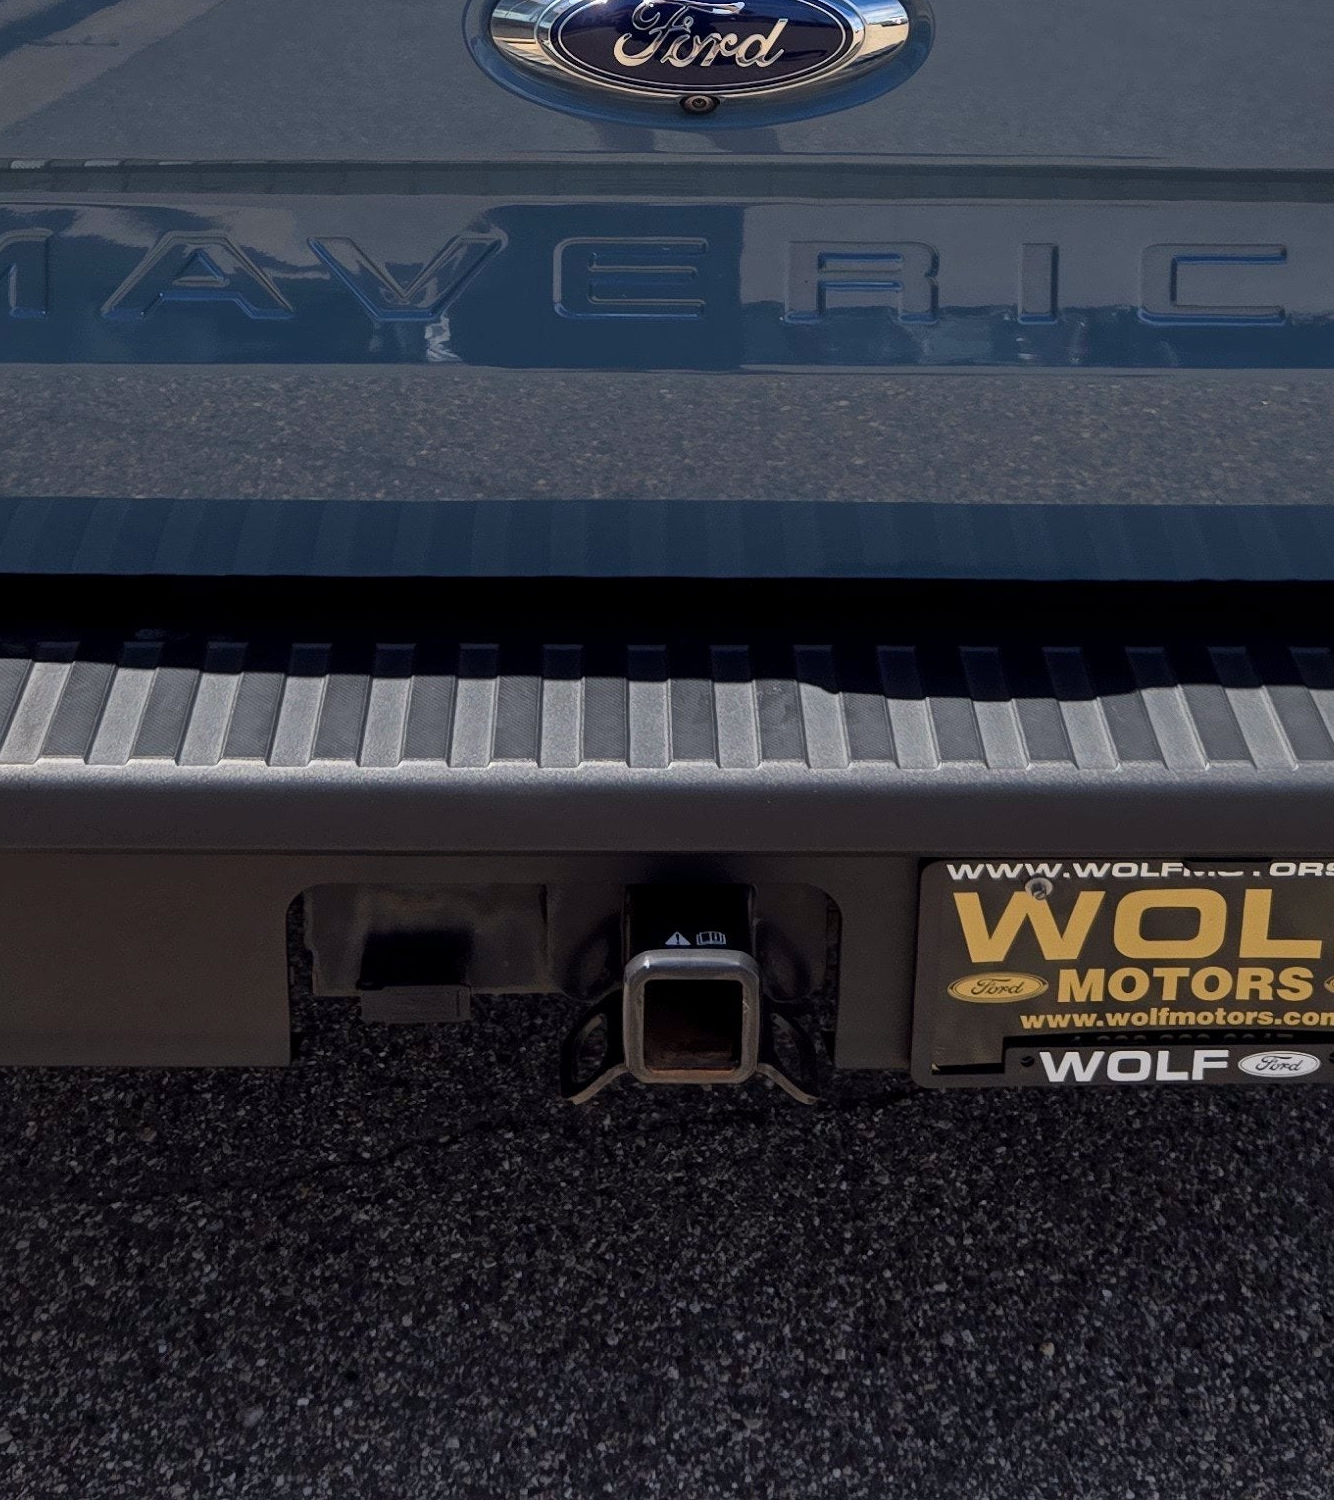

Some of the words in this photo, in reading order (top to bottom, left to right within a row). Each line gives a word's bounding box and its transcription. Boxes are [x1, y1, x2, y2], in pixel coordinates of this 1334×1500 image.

[970, 977, 1025, 996] Ford
[1057, 966, 1314, 1003] MOTORS
[1038, 1049, 1230, 1083] WOLF
[1254, 1051, 1302, 1072] Ford
